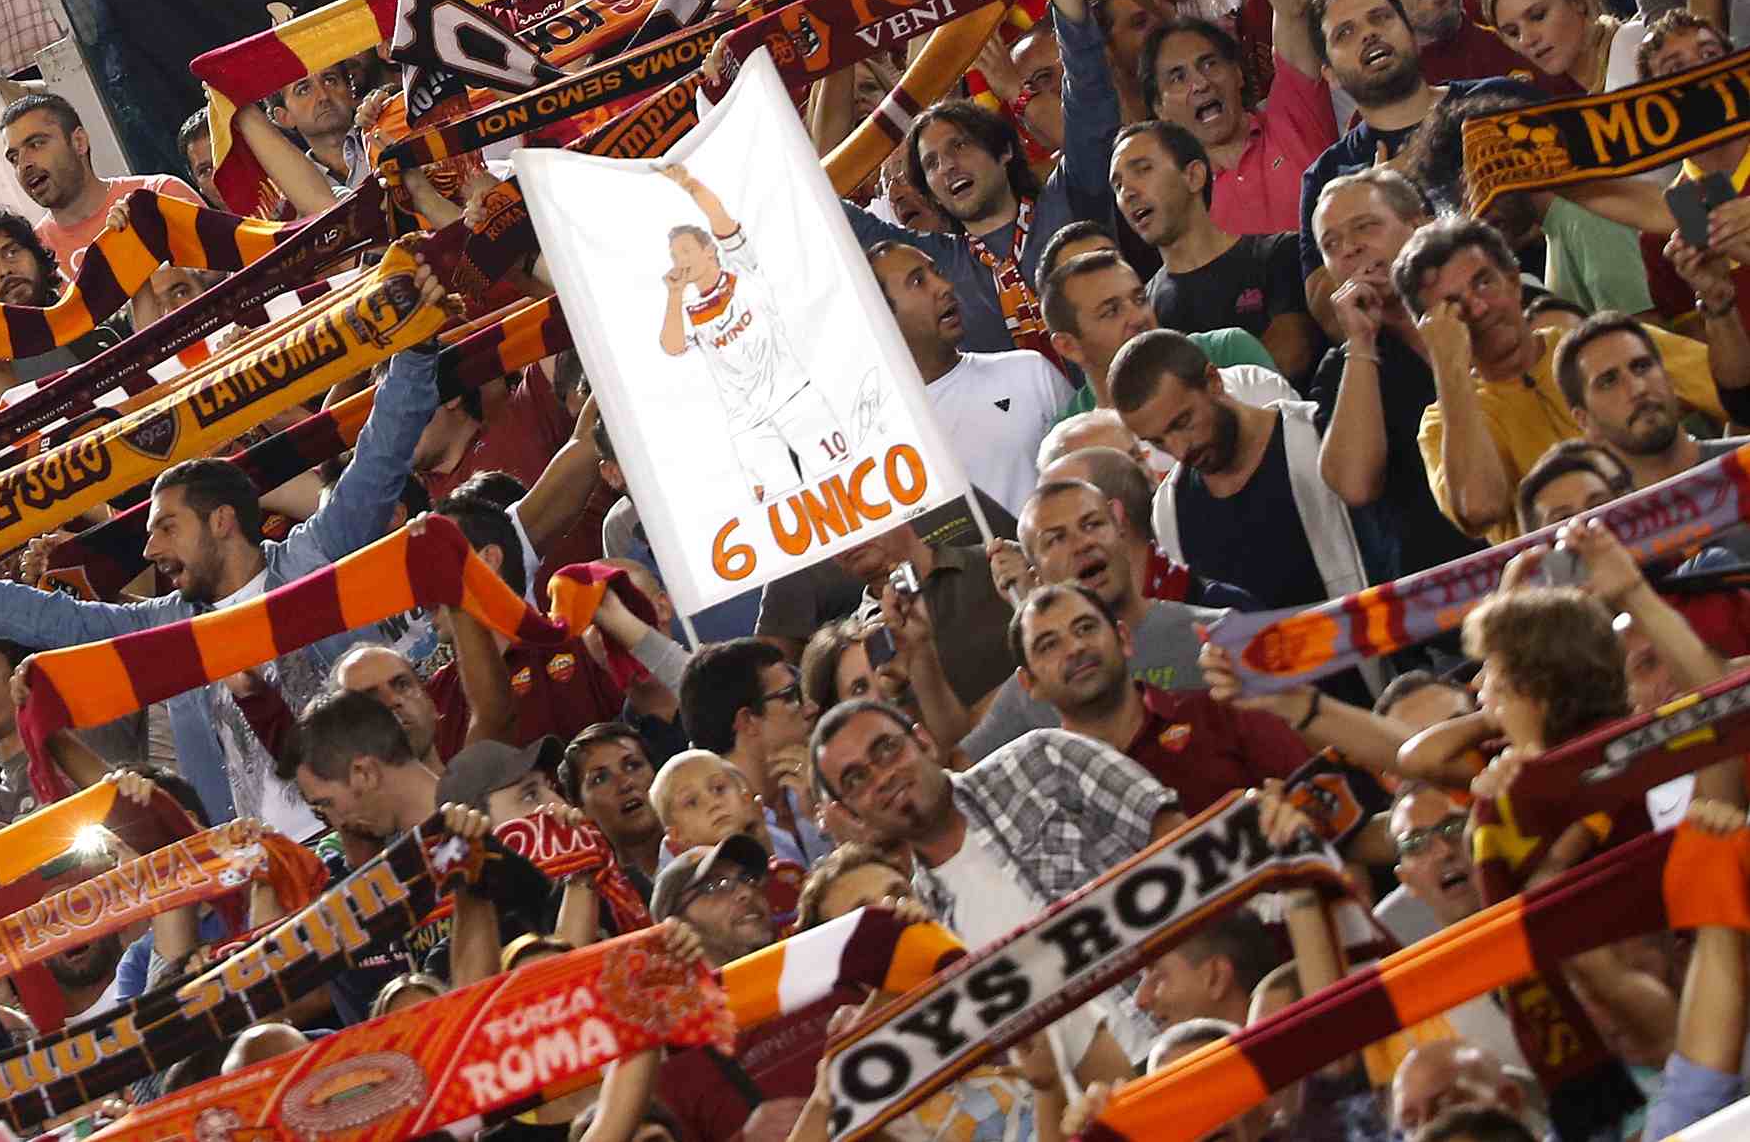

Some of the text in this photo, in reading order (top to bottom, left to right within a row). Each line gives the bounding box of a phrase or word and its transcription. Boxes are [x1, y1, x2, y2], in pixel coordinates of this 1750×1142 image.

[534, 74, 624, 109] SEMO
[476, 107, 531, 138] NOI
[819, 429, 850, 461] 10
[711, 442, 930, 583] 6 UNICO
[24, 838, 213, 954] ROMA
[481, 985, 597, 1045] FORZA
[458, 1015, 621, 1110] ROMA
